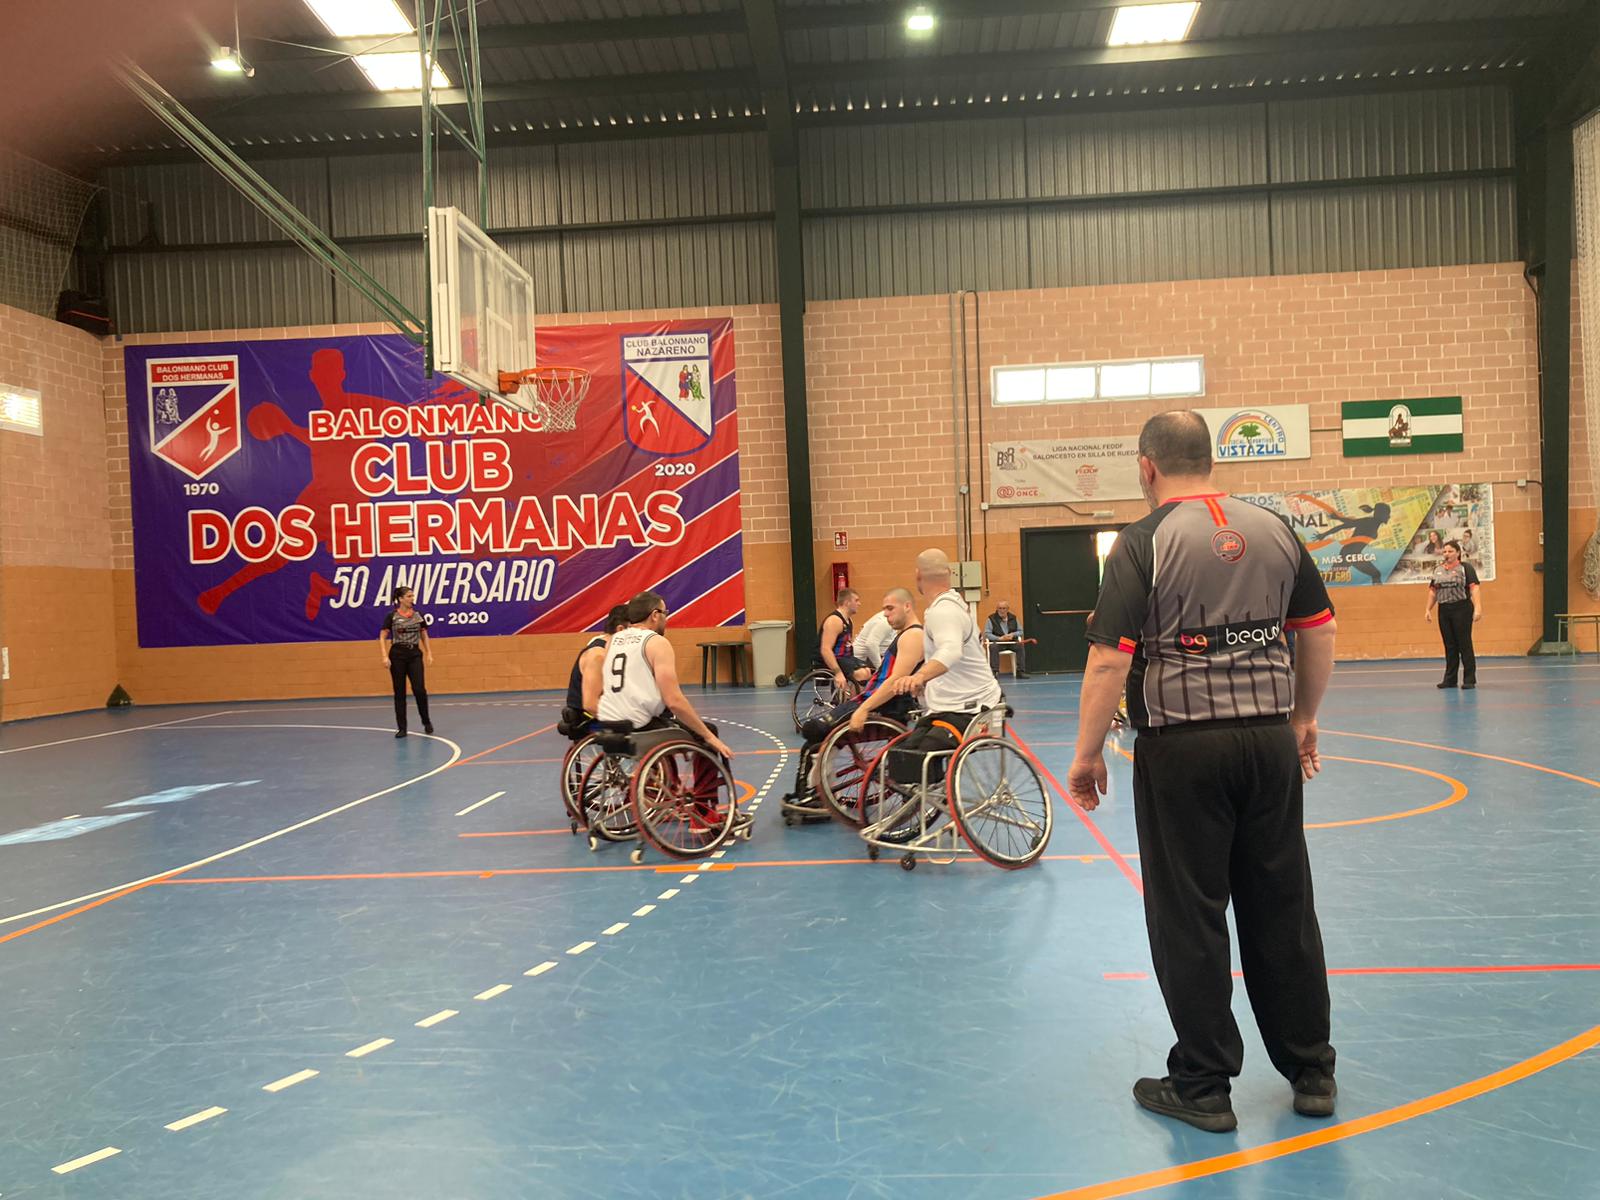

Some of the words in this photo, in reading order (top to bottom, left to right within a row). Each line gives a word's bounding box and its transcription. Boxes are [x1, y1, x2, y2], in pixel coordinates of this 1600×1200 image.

[626, 339, 649, 348] CLUB
[651, 336, 706, 346] BALONMANO
[636, 345, 696, 357] NAZARENO
[156, 364, 207, 374] BALONMANO
[208, 363, 229, 371] CLUB
[162, 374, 180, 382] DOS
[180, 372, 224, 381] HERMANAS
[1068, 444, 1101, 452] NACIONAL
[1219, 443, 1284, 457] VISTAZUL
[351, 438, 513, 497] CLUB
[654, 462, 696, 476] 2020
[183, 482, 220, 496] 1970
[188, 504, 318, 564] DOS
[330, 489, 686, 559] HERMANAS
[1346, 553, 1377, 562] CERCA
[329, 565, 370, 608] 50
[374, 559, 556, 607] ANIVERSARIO
[448, 611, 489, 625] 2020
[611, 653, 627, 693] 9
